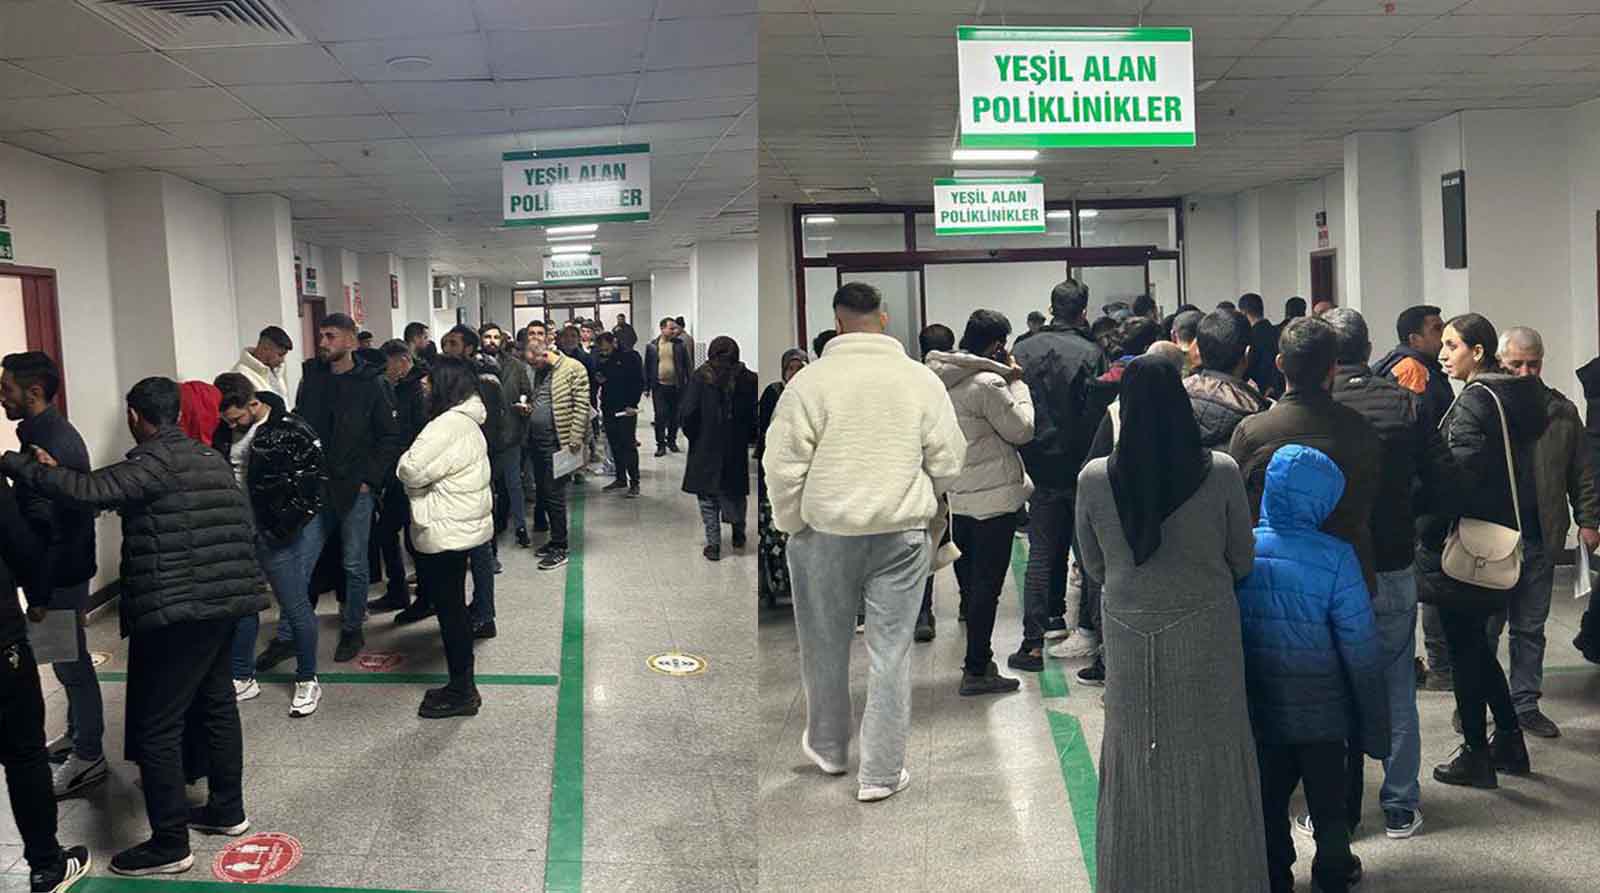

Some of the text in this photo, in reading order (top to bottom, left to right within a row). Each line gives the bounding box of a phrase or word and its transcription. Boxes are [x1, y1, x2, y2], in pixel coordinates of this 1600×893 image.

[994, 50, 1157, 85] YEŞİL ALAN
[972, 91, 1182, 123] POLİKLİNİKLER
[579, 163, 626, 183] ALAN
[950, 188, 1027, 205] YEŞİL ALAN
[940, 207, 1039, 223] POLİKLİNİKLER
